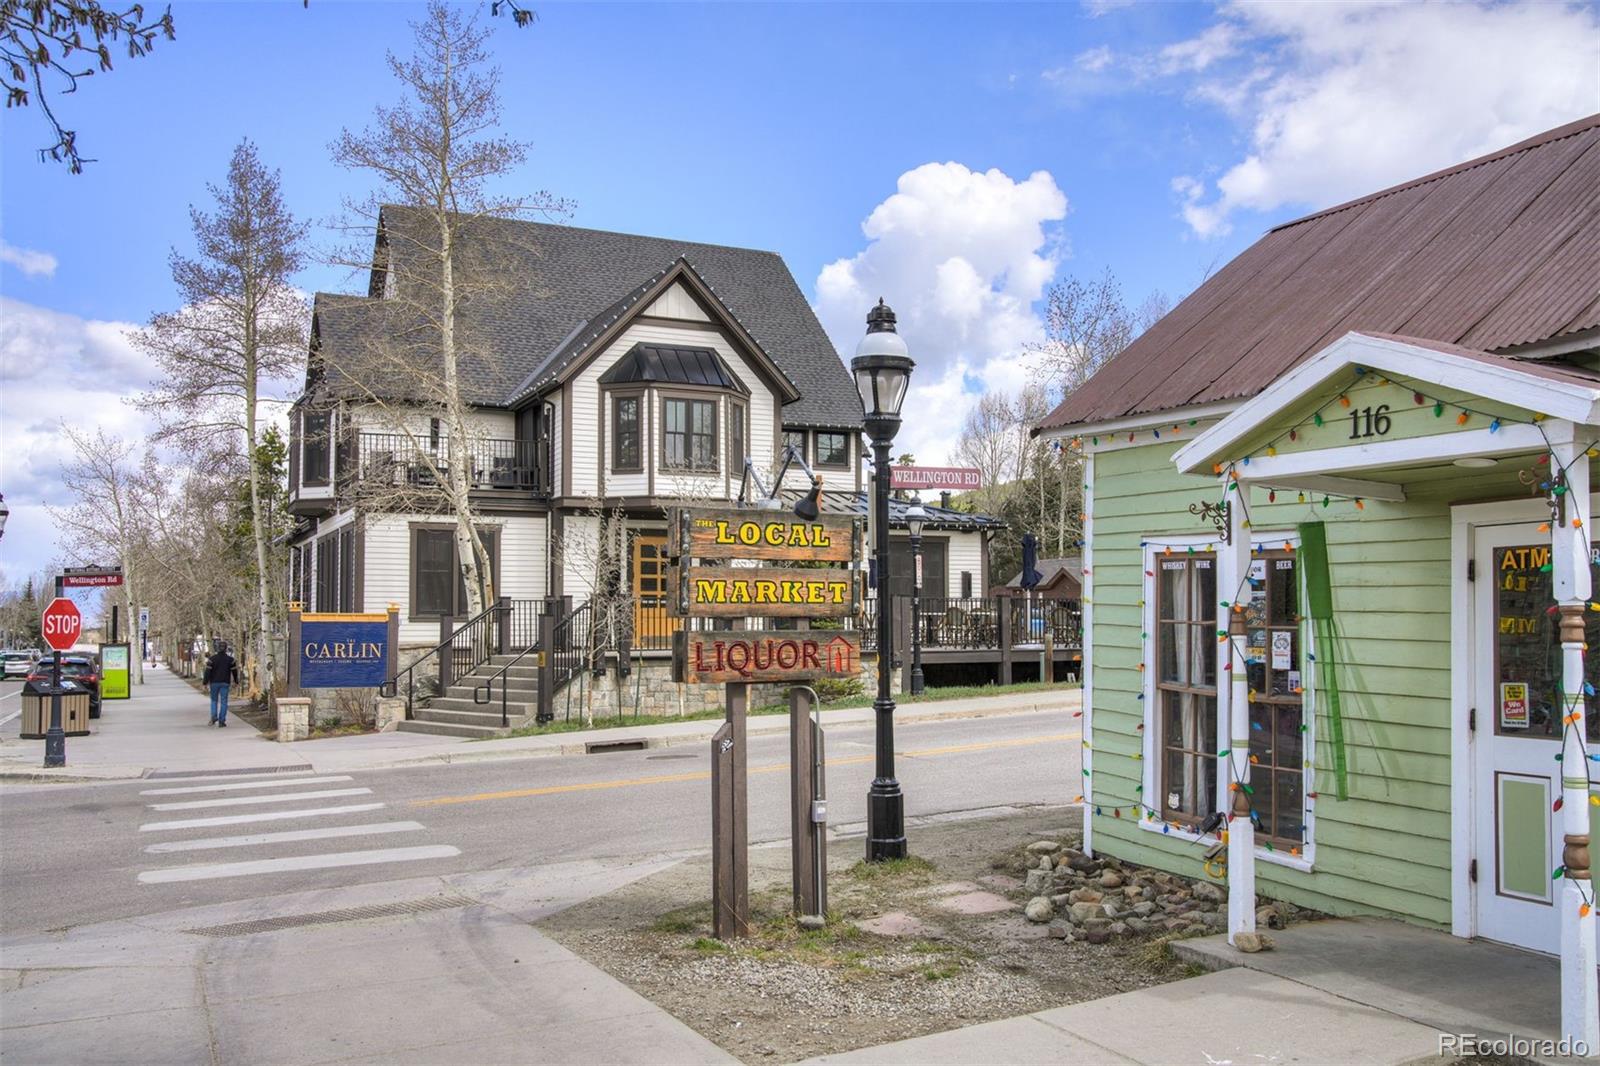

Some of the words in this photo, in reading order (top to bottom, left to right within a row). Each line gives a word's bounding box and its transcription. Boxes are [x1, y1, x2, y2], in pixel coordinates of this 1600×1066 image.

[1349, 404, 1391, 439] 116
[893, 470, 963, 484] WELLINGTON
[965, 472, 979, 485] RD
[695, 520, 715, 528] THE
[716, 520, 830, 547] LOCAL
[1275, 560, 1292, 570] BEER
[1501, 548, 1548, 570] ATM
[69, 577, 106, 585] Wellington
[107, 576, 118, 584] Rd
[696, 579, 847, 604] MARKET
[45, 614, 79, 634] STOP
[305, 642, 383, 658] CARLIN
[695, 639, 822, 677] LIQUOR
[1505, 706, 1525, 714] Card
